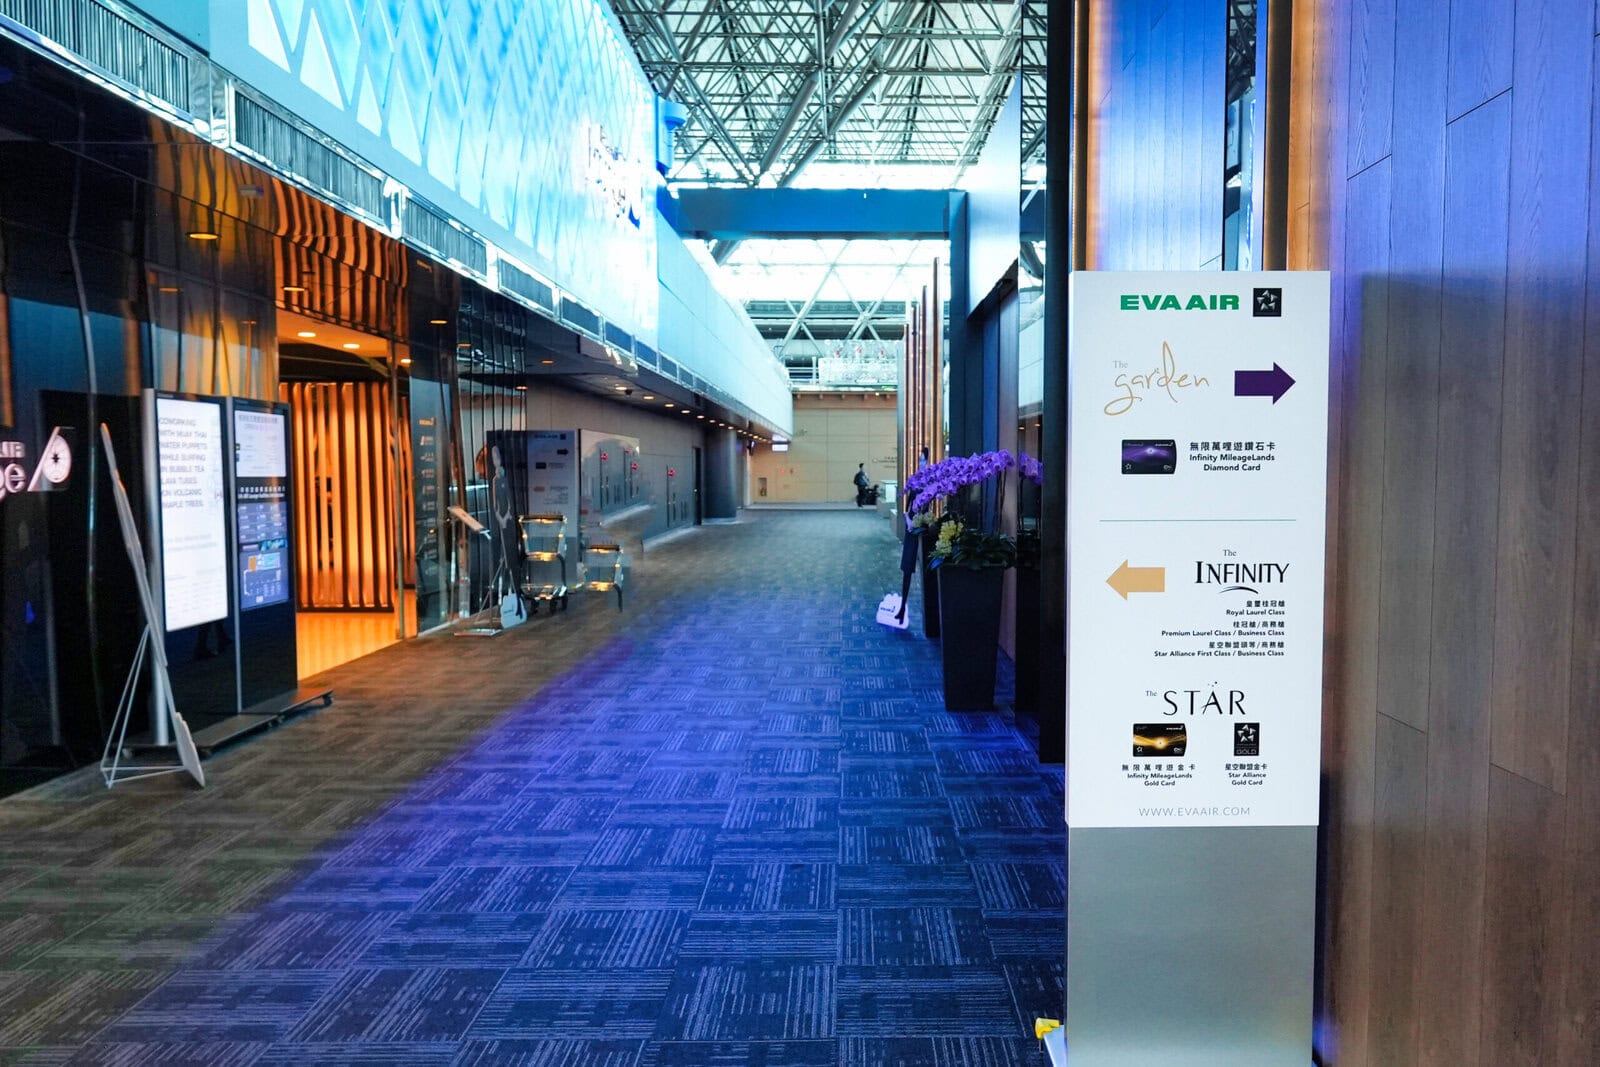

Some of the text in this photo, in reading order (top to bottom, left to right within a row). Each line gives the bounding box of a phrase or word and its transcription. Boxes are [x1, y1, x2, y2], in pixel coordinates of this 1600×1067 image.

[1112, 359, 1129, 369] The
[1103, 340, 1210, 417] garden
[1189, 453, 1275, 463] Infinity MileageLands
[1203, 463, 1262, 472] Diamond Card
[1222, 548, 1237, 557] The
[1195, 560, 1290, 585] INFINITY
[1225, 608, 1285, 617] Royal Laurel Class
[1161, 629, 1191, 637] Premium
[1192, 629, 1213, 637] Laurel
[1214, 629, 1232, 637] Class
[1238, 629, 1266, 637] Business
[1267, 629, 1285, 637] Class
[1145, 688, 1247, 717] The STAR
[1126, 772, 1193, 780] Infinity MileageLands
[1228, 771, 1267, 779] Star Alliance
[1144, 779, 1176, 787] Gold Card
[1231, 779, 1263, 787] Gold Card
[1138, 806, 1251, 817] WWW.EVAAIR.COM
